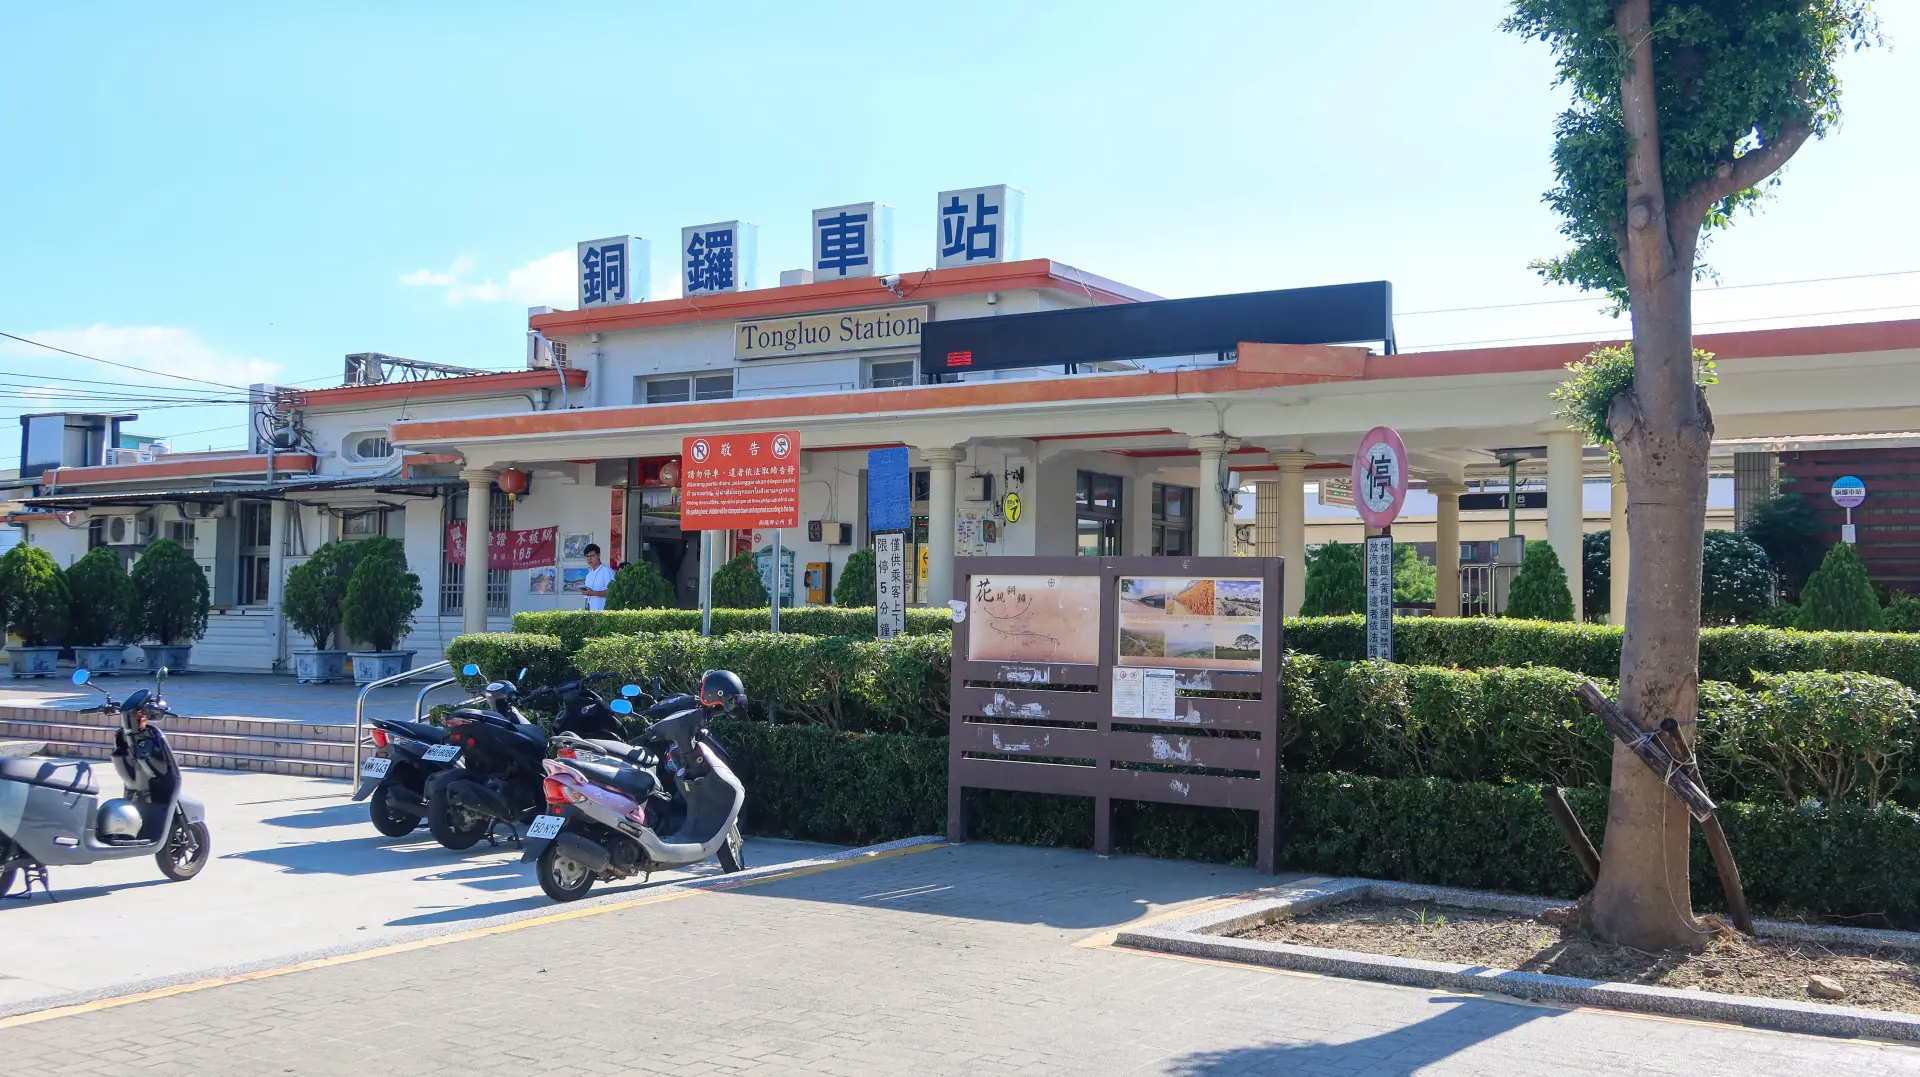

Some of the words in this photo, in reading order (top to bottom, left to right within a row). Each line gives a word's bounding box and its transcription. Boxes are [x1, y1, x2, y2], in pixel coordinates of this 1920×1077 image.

[583, 193, 999, 304] 銅鑼車站
[741, 321, 831, 350] Tongluo
[839, 312, 921, 342] Station
[1366, 454, 1391, 500] 停
[512, 547, 531, 560] 165
[877, 538, 890, 637] 限停5分鐘
